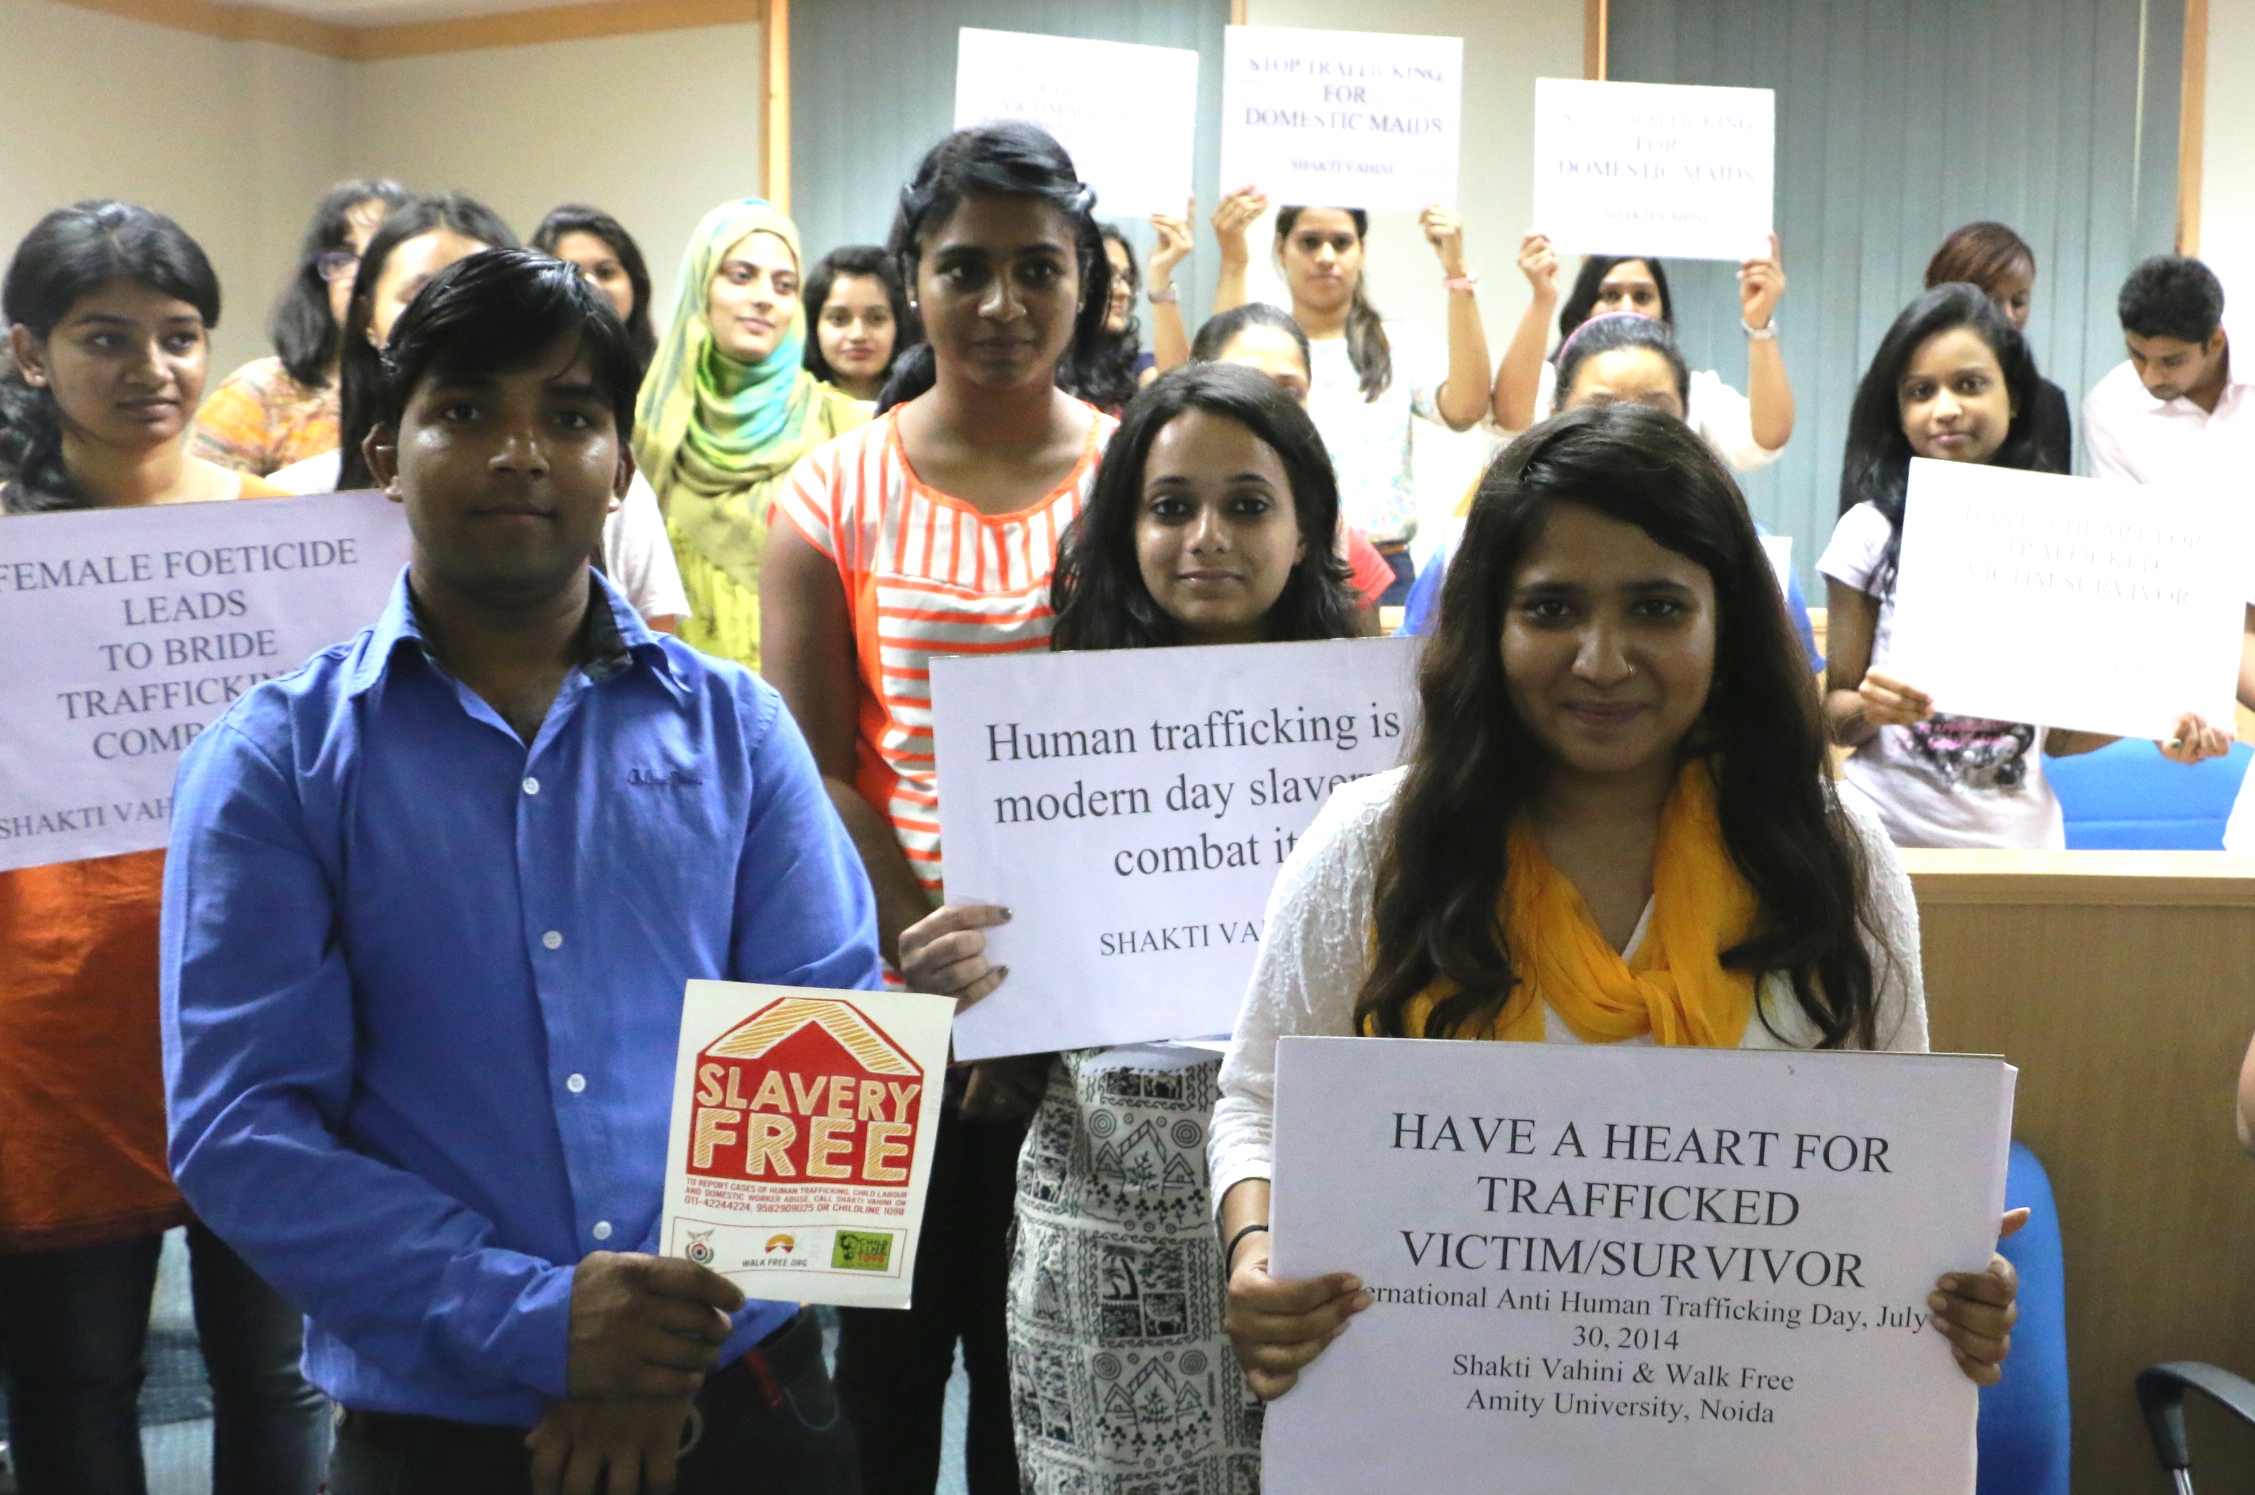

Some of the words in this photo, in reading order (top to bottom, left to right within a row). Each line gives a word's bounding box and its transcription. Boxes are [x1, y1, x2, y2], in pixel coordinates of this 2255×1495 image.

[1248, 56, 1301, 73] STOP
[1307, 60, 1443, 83] TRAFFICKING
[1322, 84, 1368, 104] FOR
[1245, 106, 1364, 130] DOMESTIC
[1368, 113, 1444, 134] MAIDS
[1633, 135, 1678, 152] FOR
[1290, 158, 1341, 173] SHAKTI
[1344, 160, 1395, 175] VAHINI
[1557, 158, 1670, 179] DOMESTIC
[1681, 164, 1755, 182] MAIDS
[164, 538, 359, 580] FOETICIDE
[1967, 561, 2191, 606] VICTIMSURVIVOR
[123, 590, 247, 627] LEADS
[99, 641, 153, 672] TO
[165, 628, 279, 667] BRIDE
[57, 668, 299, 721] TRAFFICK
[985, 722, 1137, 762] Human
[1150, 705, 1359, 752] trafficking
[1370, 701, 1401, 738] is
[995, 779, 1151, 823] modern
[1165, 773, 1235, 819] day
[1250, 767, 1373, 806] slave
[0, 805, 106, 840] SHAKTI
[1114, 832, 1260, 877] combat
[1273, 826, 1298, 864] it
[1100, 923, 1210, 957] SHAKTI
[1219, 919, 1265, 945] VA
[696, 1062, 922, 1123] SLAVERY
[692, 1107, 912, 1182] FREE
[1390, 1112, 1537, 1155] HAVE
[1551, 1121, 1588, 1159] A
[1602, 1123, 1779, 1168] HEART
[1791, 1133, 1893, 1174] FOR
[685, 1186, 702, 1195] AND
[704, 1189, 744, 1201] DOMESTIC
[747, 1194, 780, 1202] WORKER
[813, 1195, 831, 1203] CALL
[836, 1195, 864, 1204] SHAKTI
[687, 1177, 697, 1186] TO
[698, 1179, 728, 1189] REPORT
[731, 1182, 756, 1192] CASES
[758, 1185, 767, 1193] OF
[770, 1186, 798, 1194] HUMAN
[853, 1189, 876, 1197] CHILD
[877, 1190, 908, 1199] LABOUR
[1476, 1176, 1800, 1227] TRAFFICKED
[756, 1203, 814, 1213] 9582909025
[817, 1203, 829, 1212] OR
[832, 1203, 880, 1215] CHILDLINE
[884, 1206, 905, 1216] 1098
[742, 1258, 765, 1268] WALK
[1399, 1230, 1866, 1288] VICTIM/SURVIVOR
[1496, 1288, 1550, 1311] Anti
[1560, 1290, 1650, 1316] Human
[1661, 1294, 1802, 1330] Trafficking
[1811, 1303, 1868, 1332] Day,
[1876, 1305, 1929, 1334] July
[1572, 1325, 1610, 1351] 30,
[1617, 1327, 1680, 1351] 2014
[1452, 1353, 1530, 1378] Shakti
[1541, 1357, 1623, 1383] Vahini
[1632, 1362, 1655, 1385] &
[1666, 1363, 1730, 1388] Walk
[1740, 1367, 1795, 1391] Free
[1466, 1388, 1545, 1418] Amity
[1554, 1392, 1690, 1424] University,
[1700, 1398, 1775, 1424] Noida
